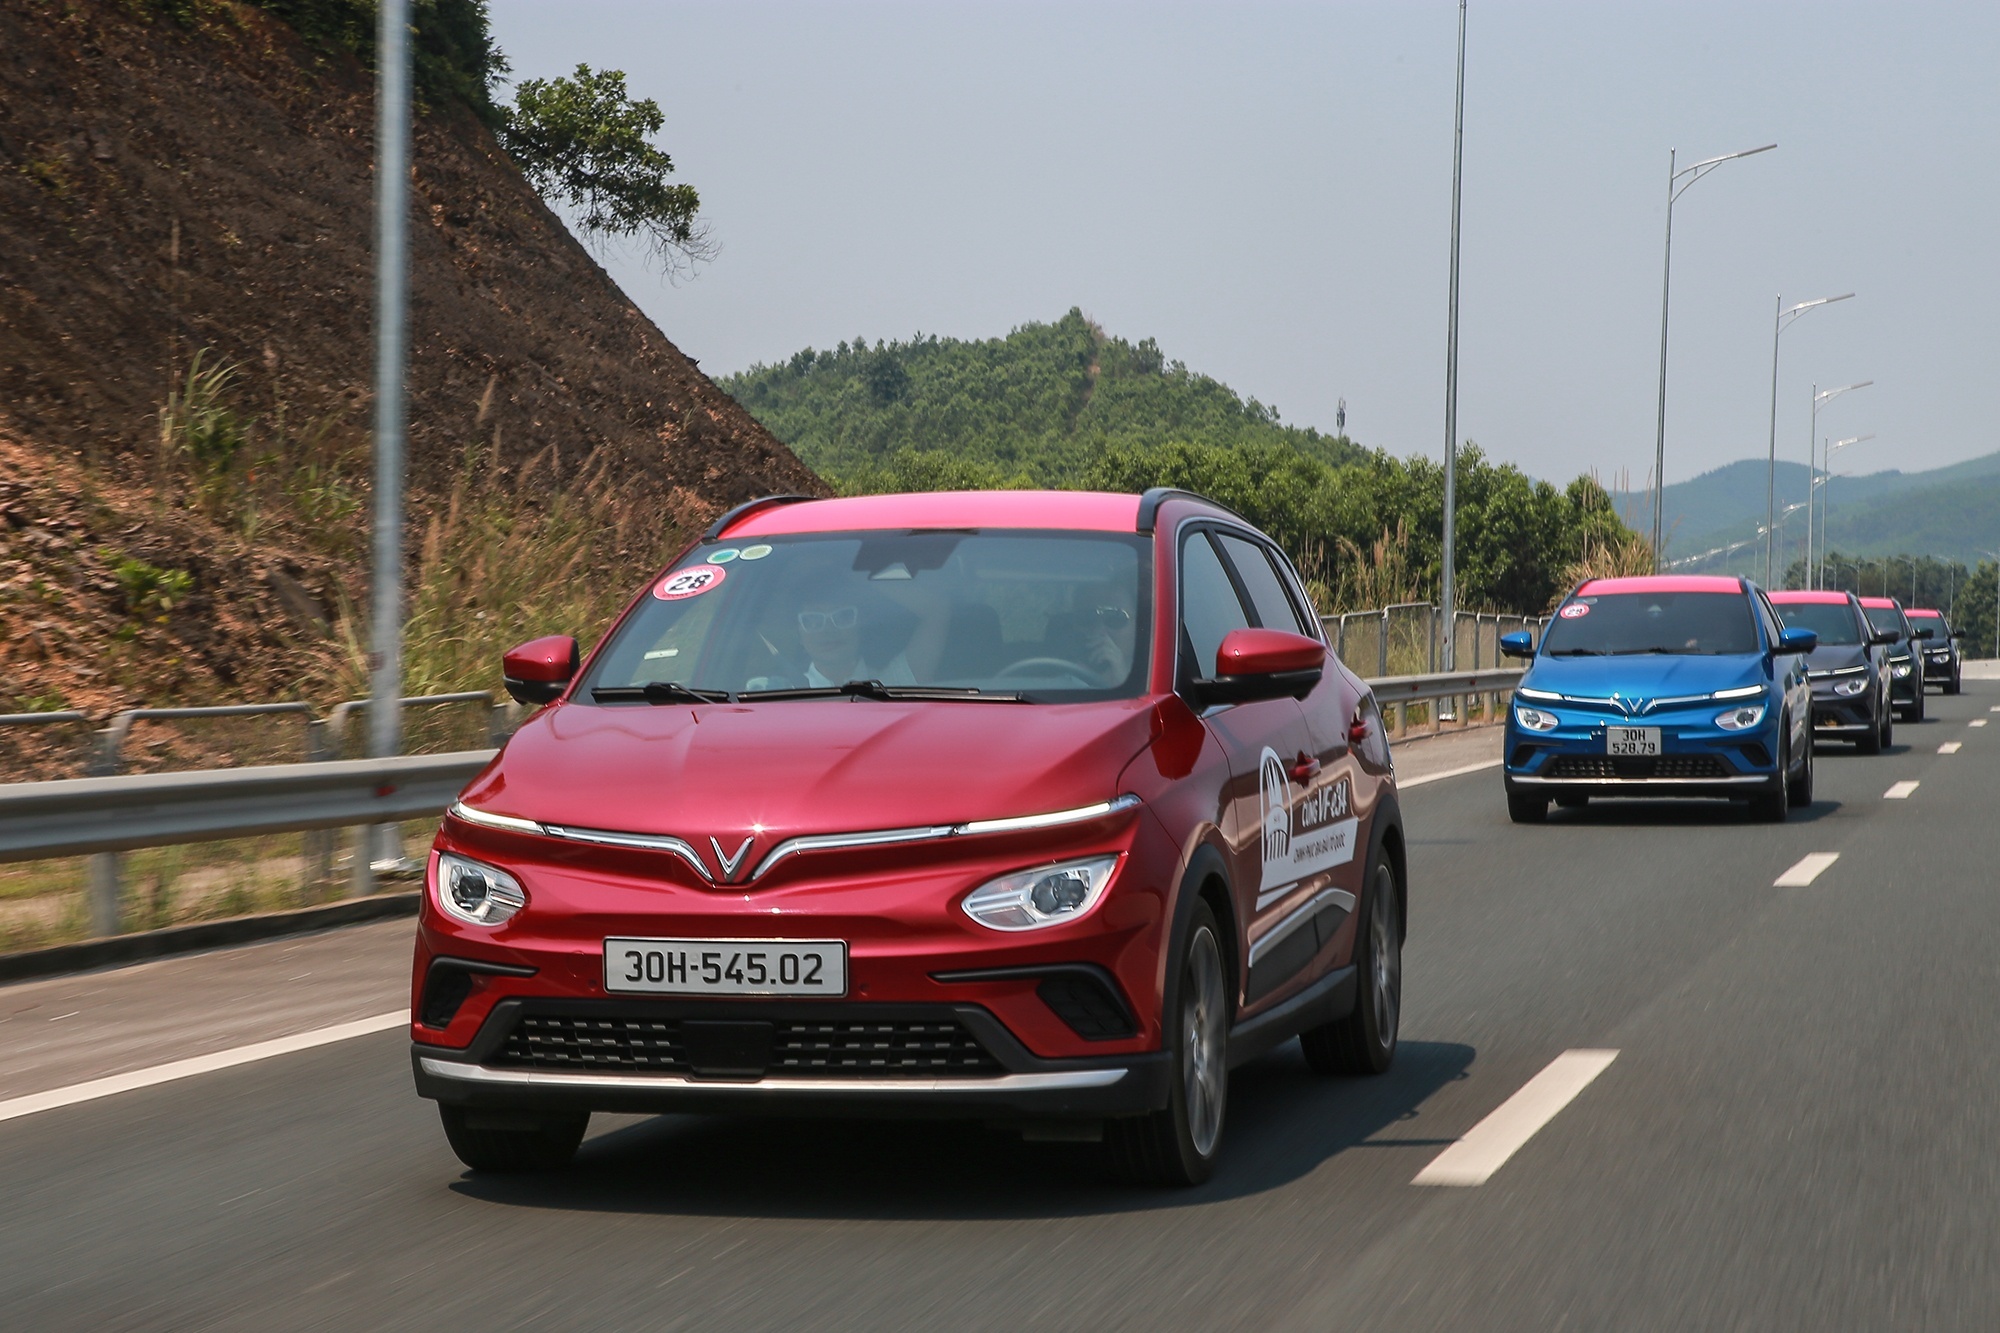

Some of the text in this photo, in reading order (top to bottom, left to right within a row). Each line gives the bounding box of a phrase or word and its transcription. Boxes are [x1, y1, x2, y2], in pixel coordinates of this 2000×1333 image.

[668, 574, 712, 592] 28
[1622, 729, 1646, 742] 30H
[1612, 742, 1656, 754] 528.79
[624, 950, 824, 986] 30H-545.02
